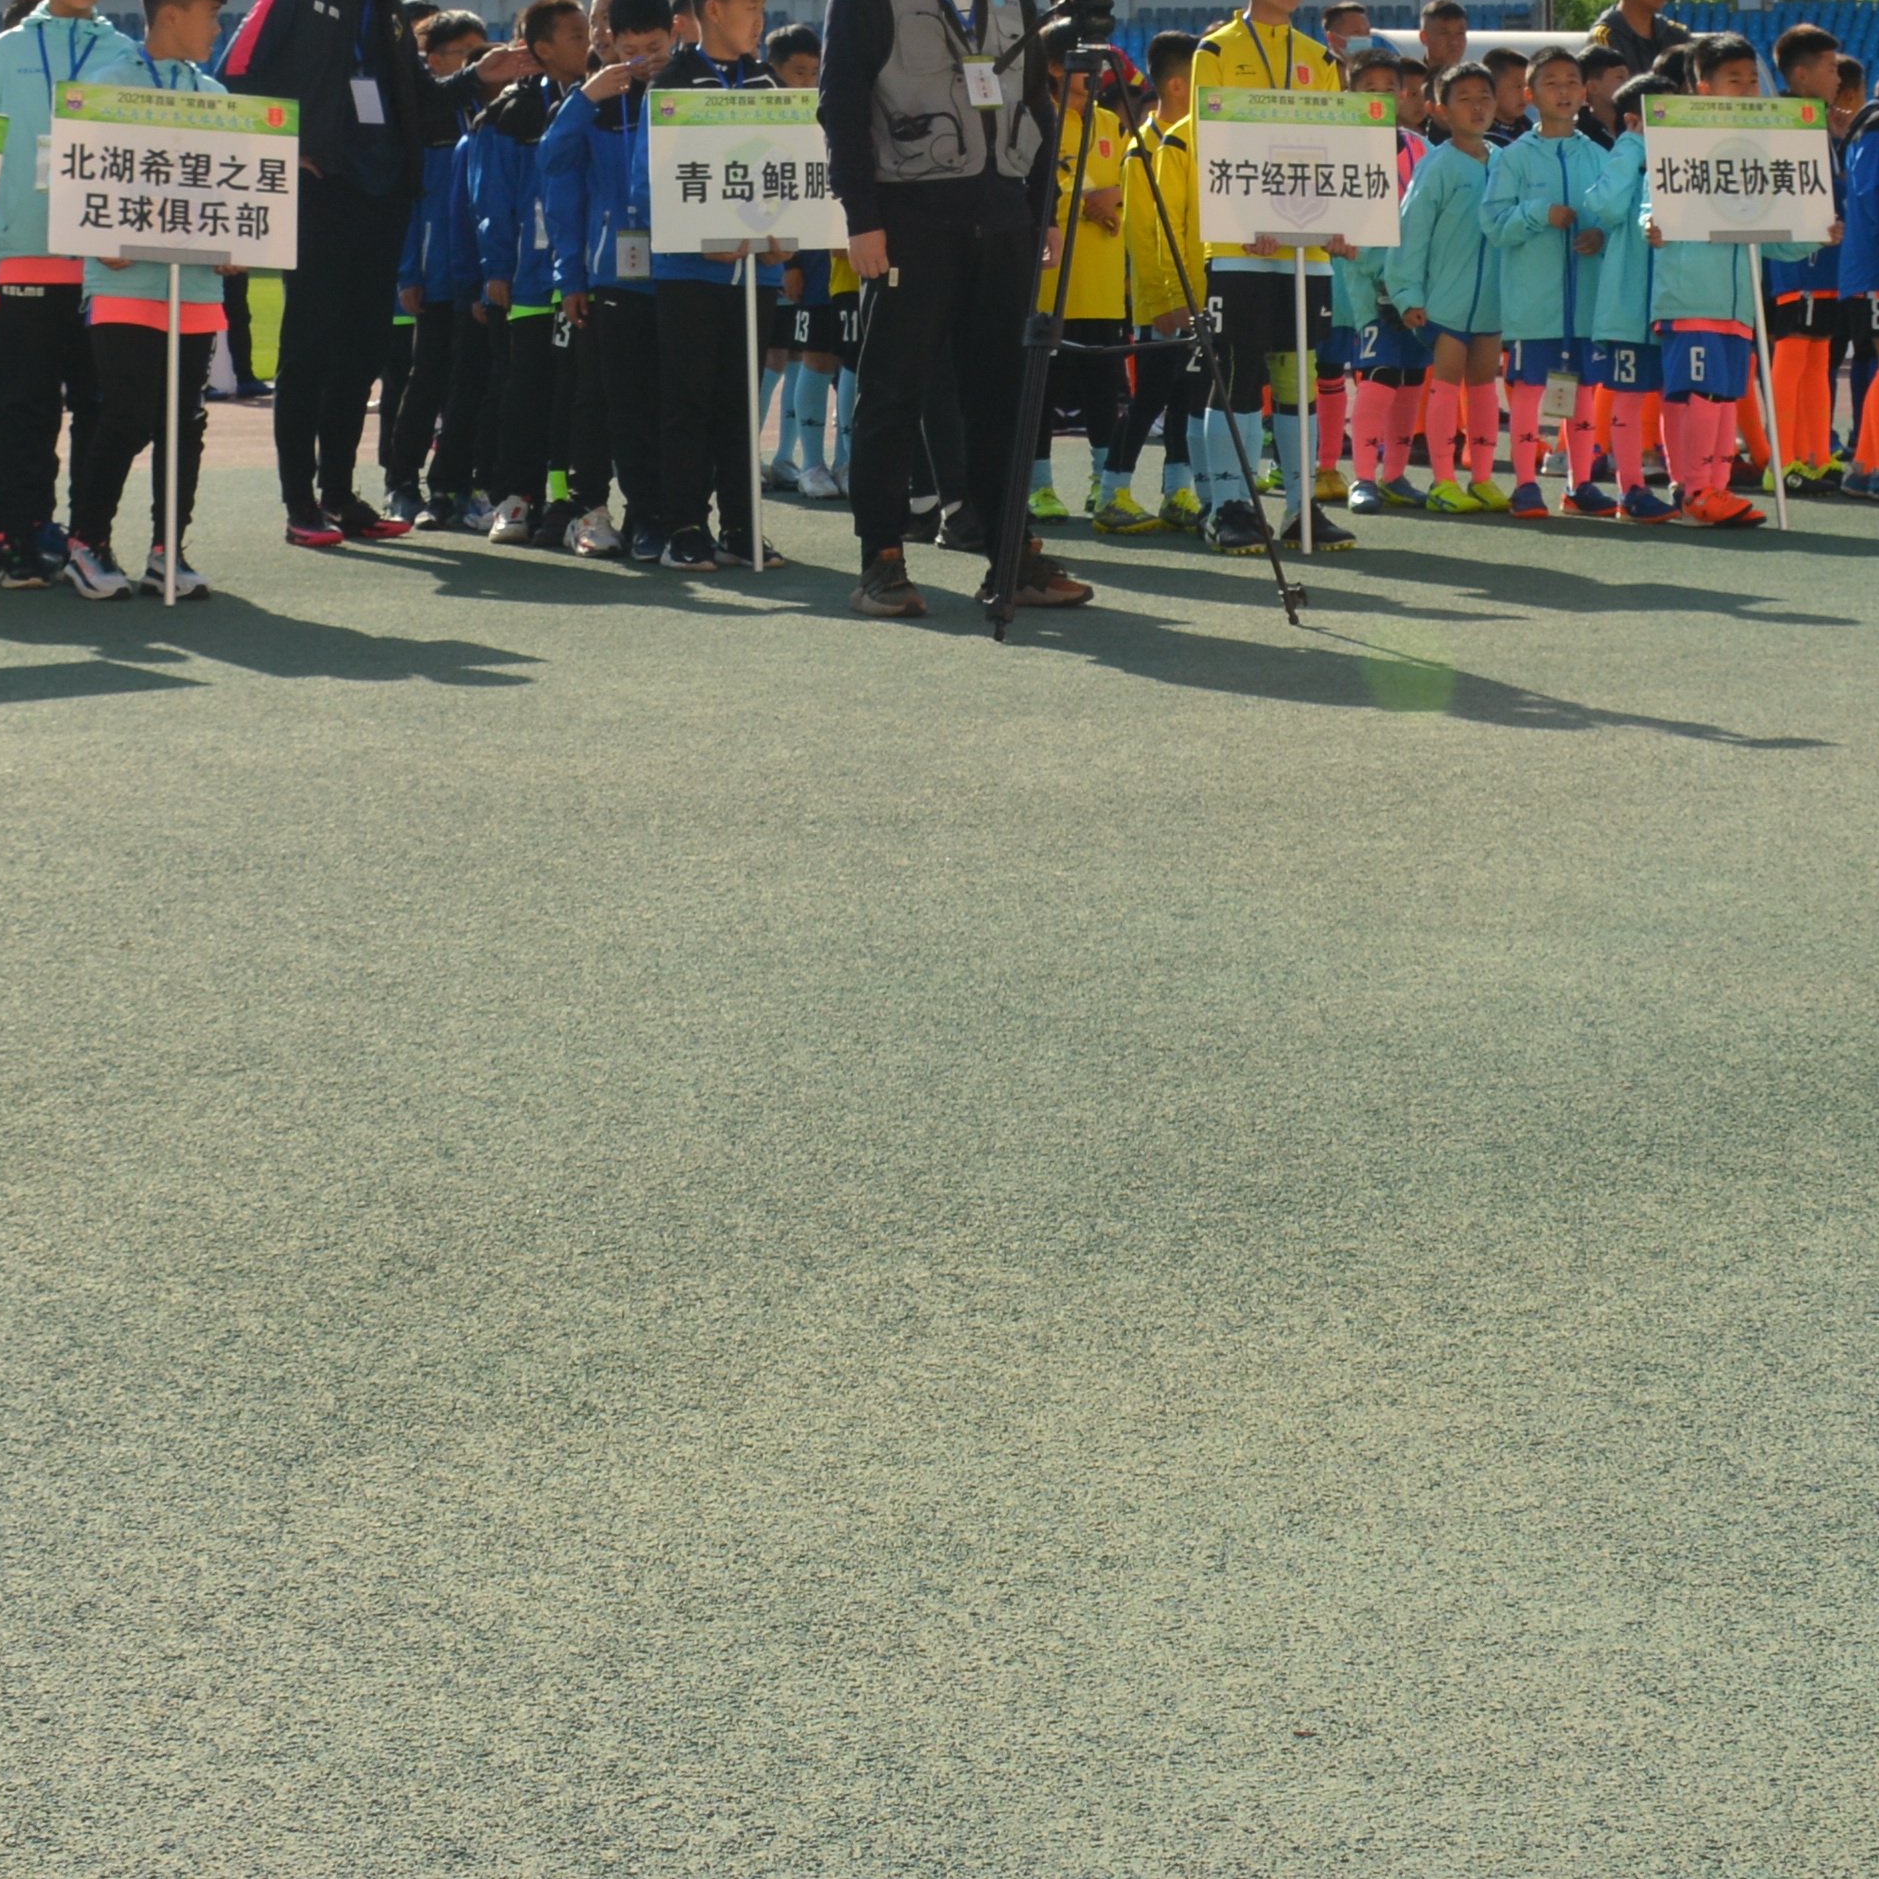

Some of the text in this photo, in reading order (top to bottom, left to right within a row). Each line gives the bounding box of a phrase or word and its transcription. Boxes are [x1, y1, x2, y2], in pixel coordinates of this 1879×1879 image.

[61, 143, 289, 196] 北湖希望之星
[1208, 158, 1390, 201] 济宁经开区足协
[1655, 158, 1827, 197] 北湖足协黄队
[79, 192, 270, 241] 足球俱乐部
[794, 309, 810, 343] 13
[1613, 348, 1637, 383] 13
[1689, 346, 1706, 382] 6
